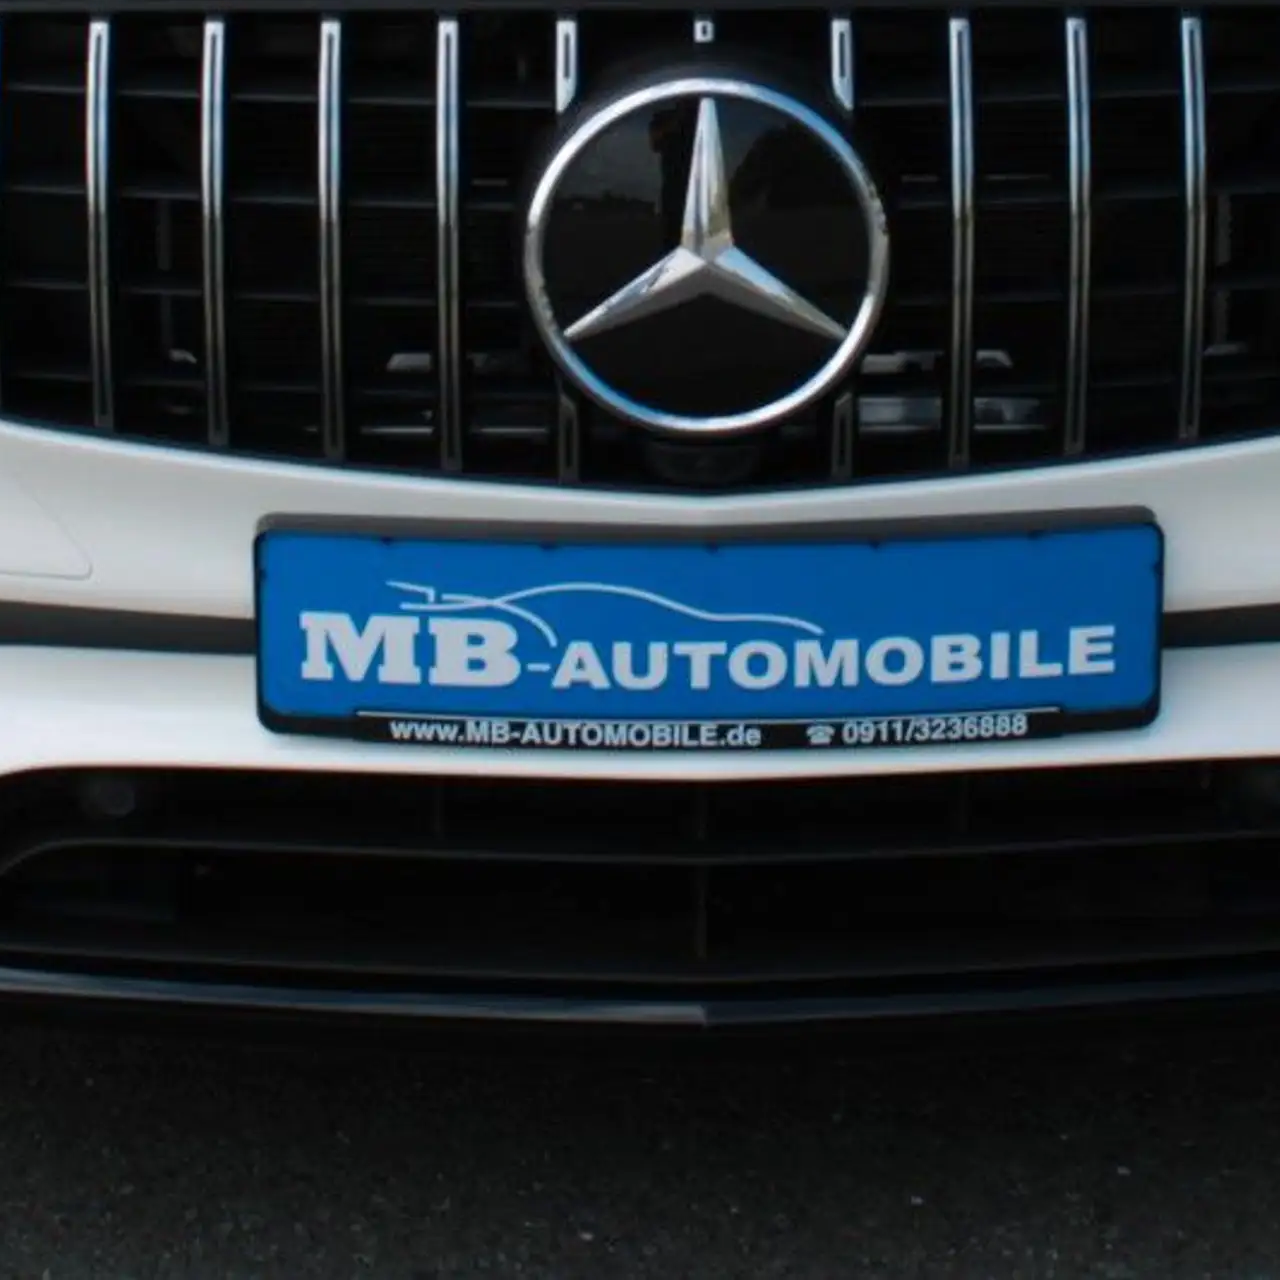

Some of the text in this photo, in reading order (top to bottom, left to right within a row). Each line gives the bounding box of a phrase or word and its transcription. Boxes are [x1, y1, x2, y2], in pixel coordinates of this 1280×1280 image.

[299, 611, 1116, 690] MB-AUTOMOBILE
[389, 714, 1029, 748] www.MB-AUTOMOBILE.de 0911/3236888
